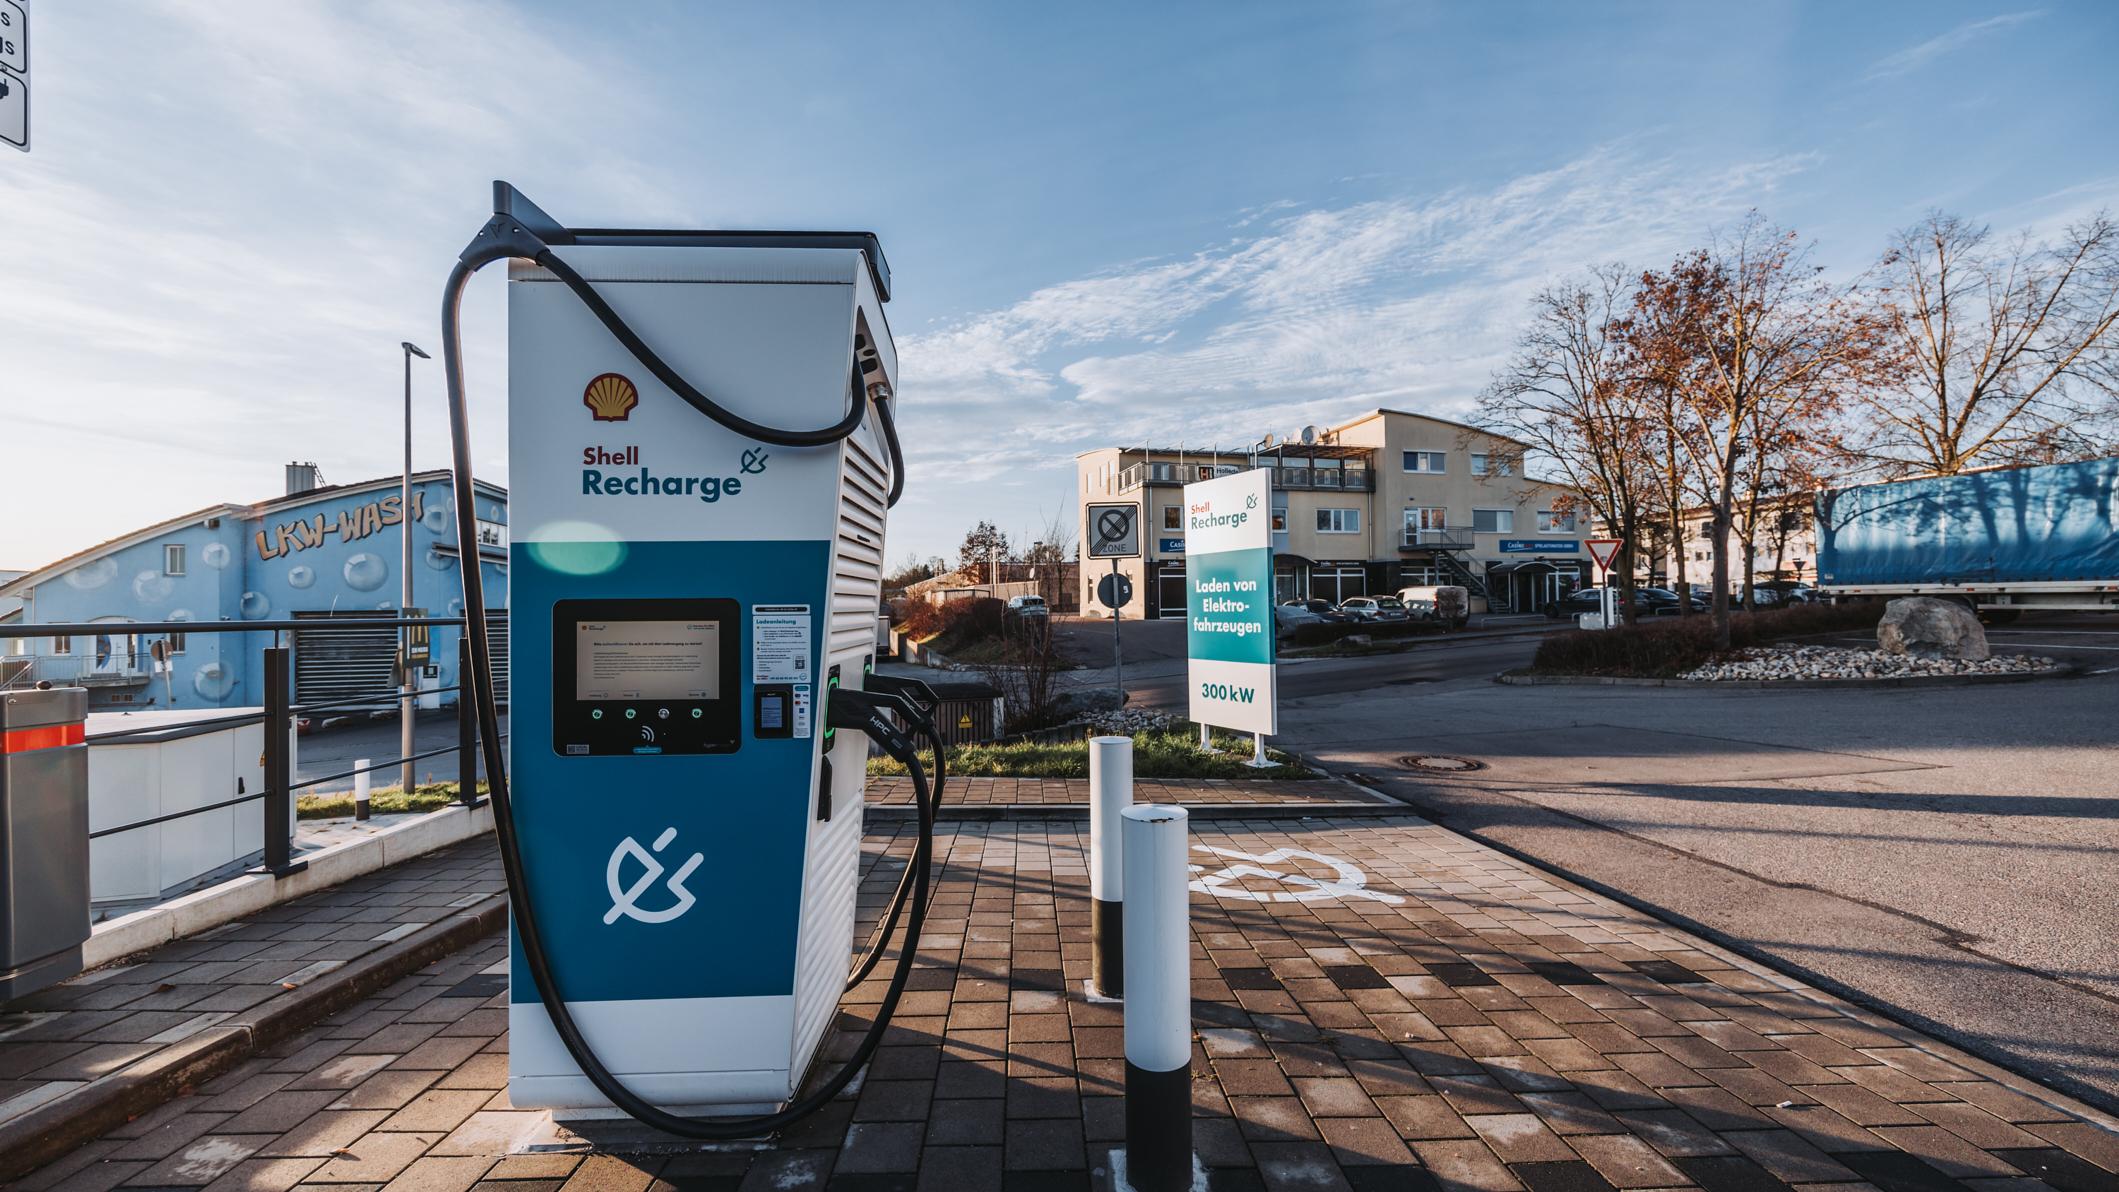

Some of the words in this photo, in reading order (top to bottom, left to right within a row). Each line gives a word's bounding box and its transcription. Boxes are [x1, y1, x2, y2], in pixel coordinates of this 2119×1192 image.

[583, 446, 639, 465] Shell
[582, 467, 741, 503] Recharge
[1191, 502, 1210, 514] Shell
[1191, 512, 1248, 530] Recharge
[1102, 544, 1127, 553] ZONE
[1195, 578, 1230, 593] Laden
[1233, 580, 1257, 592] von
[1203, 597, 1250, 613] Elektro-
[1193, 617, 1262, 637] fahrzeugen
[1202, 683, 1227, 700] 300
[1229, 685, 1255, 704] kW
[870, 715, 891, 736] HPC
